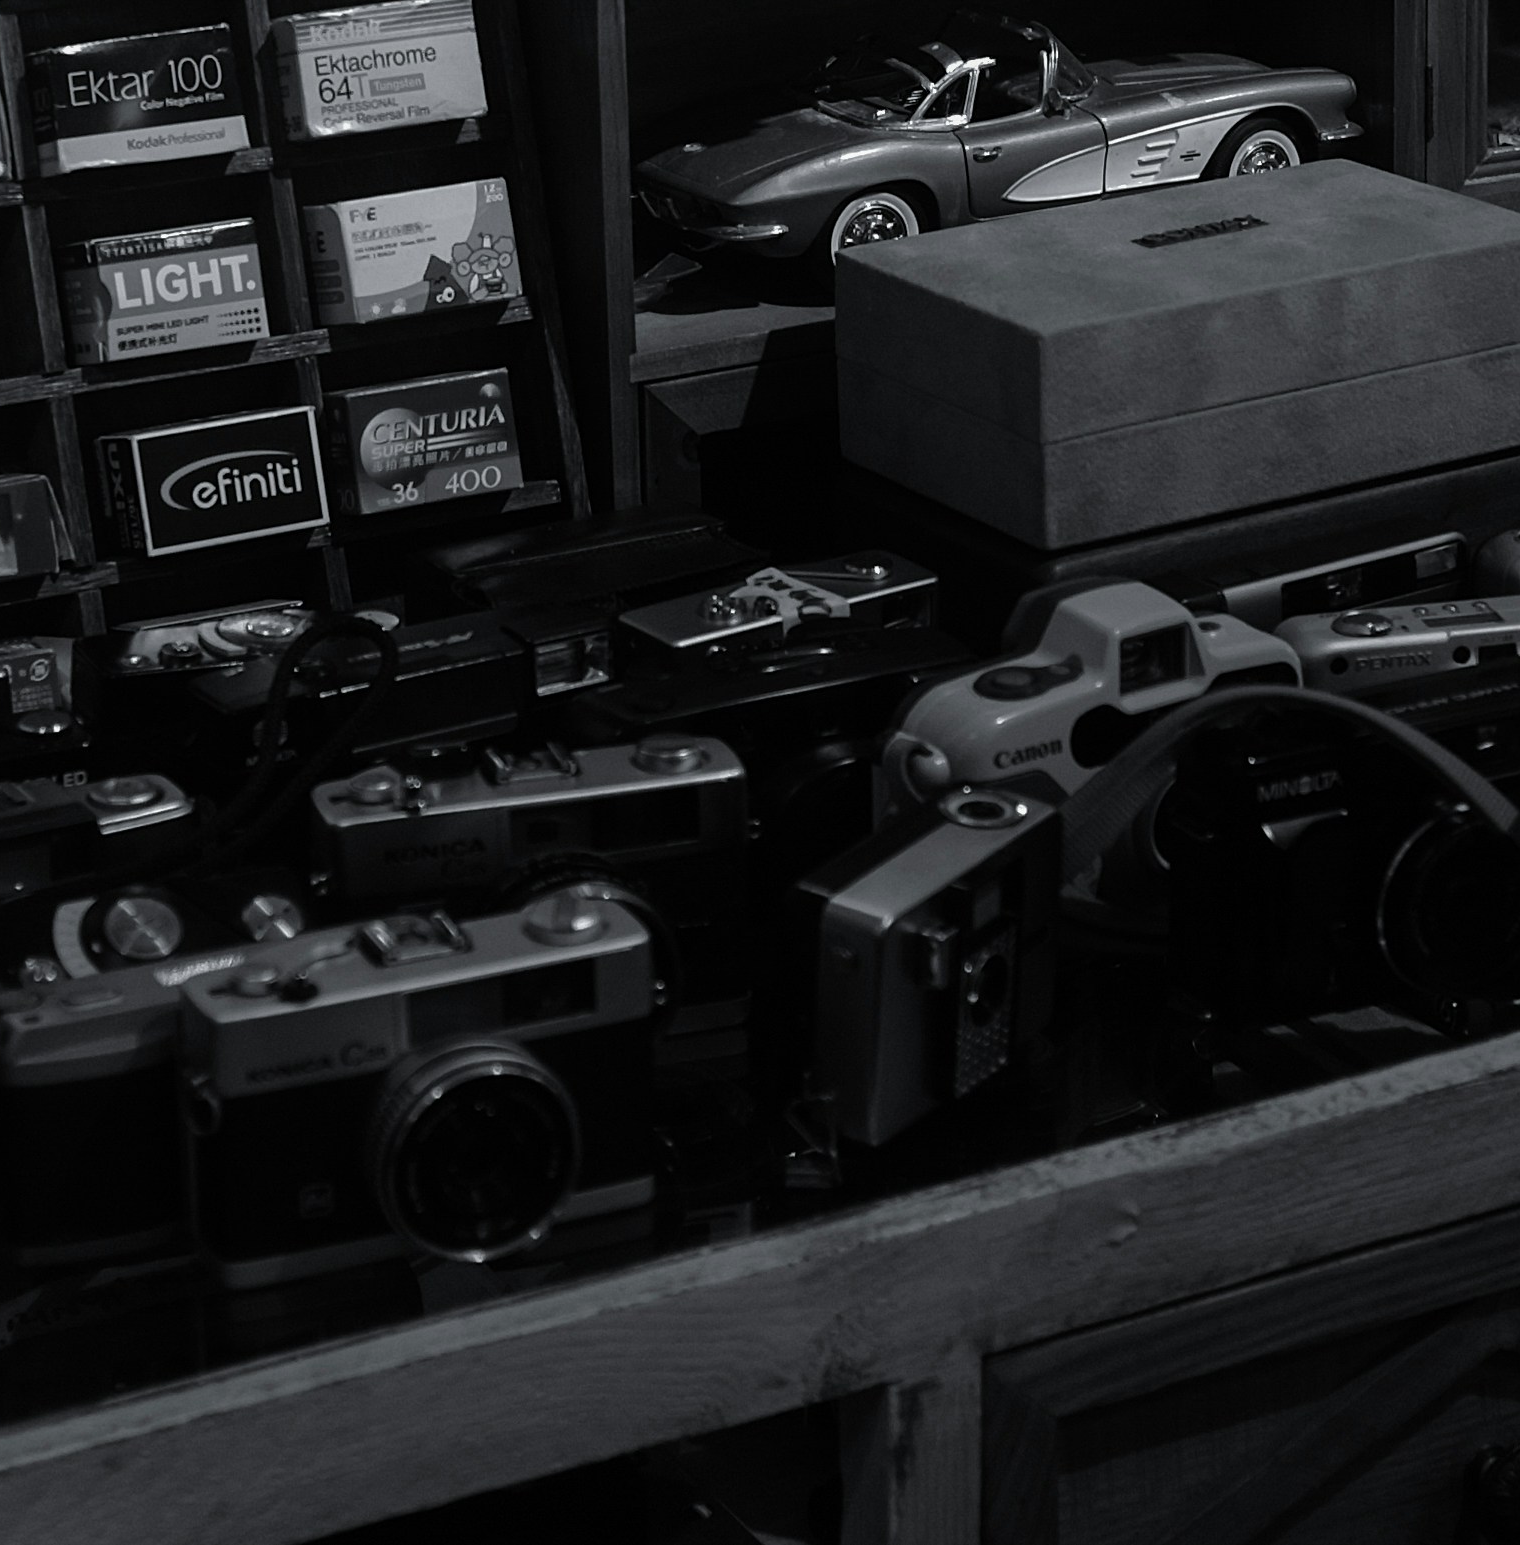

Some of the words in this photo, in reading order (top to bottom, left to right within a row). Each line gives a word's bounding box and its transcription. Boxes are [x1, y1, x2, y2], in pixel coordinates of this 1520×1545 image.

[309, 19, 381, 43] Kodak
[314, 46, 437, 76] Ektachrome
[66, 69, 156, 107] Ektar
[167, 53, 223, 94] 100
[372, 76, 423, 92] Tungsten
[205, 91, 226, 103] Film
[320, 98, 400, 116] PROFESSIONAL
[356, 107, 406, 124] Reversal
[407, 105, 431, 118] Film
[127, 136, 168, 151] Kodak
[167, 127, 226, 146] Professional
[114, 254, 256, 310] LIGHT.
[116, 324, 144, 337] SUPER
[166, 319, 183, 330] LED
[184, 315, 210, 327] LIGHT
[372, 403, 506, 445] CENTURIA
[371, 439, 426, 460] SUPER
[192, 458, 303, 509] efiniti
[392, 481, 420, 504] 36
[445, 465, 502, 494] 400
[1356, 650, 1433, 670] PENTAX
[993, 740, 1063, 770] Canon
